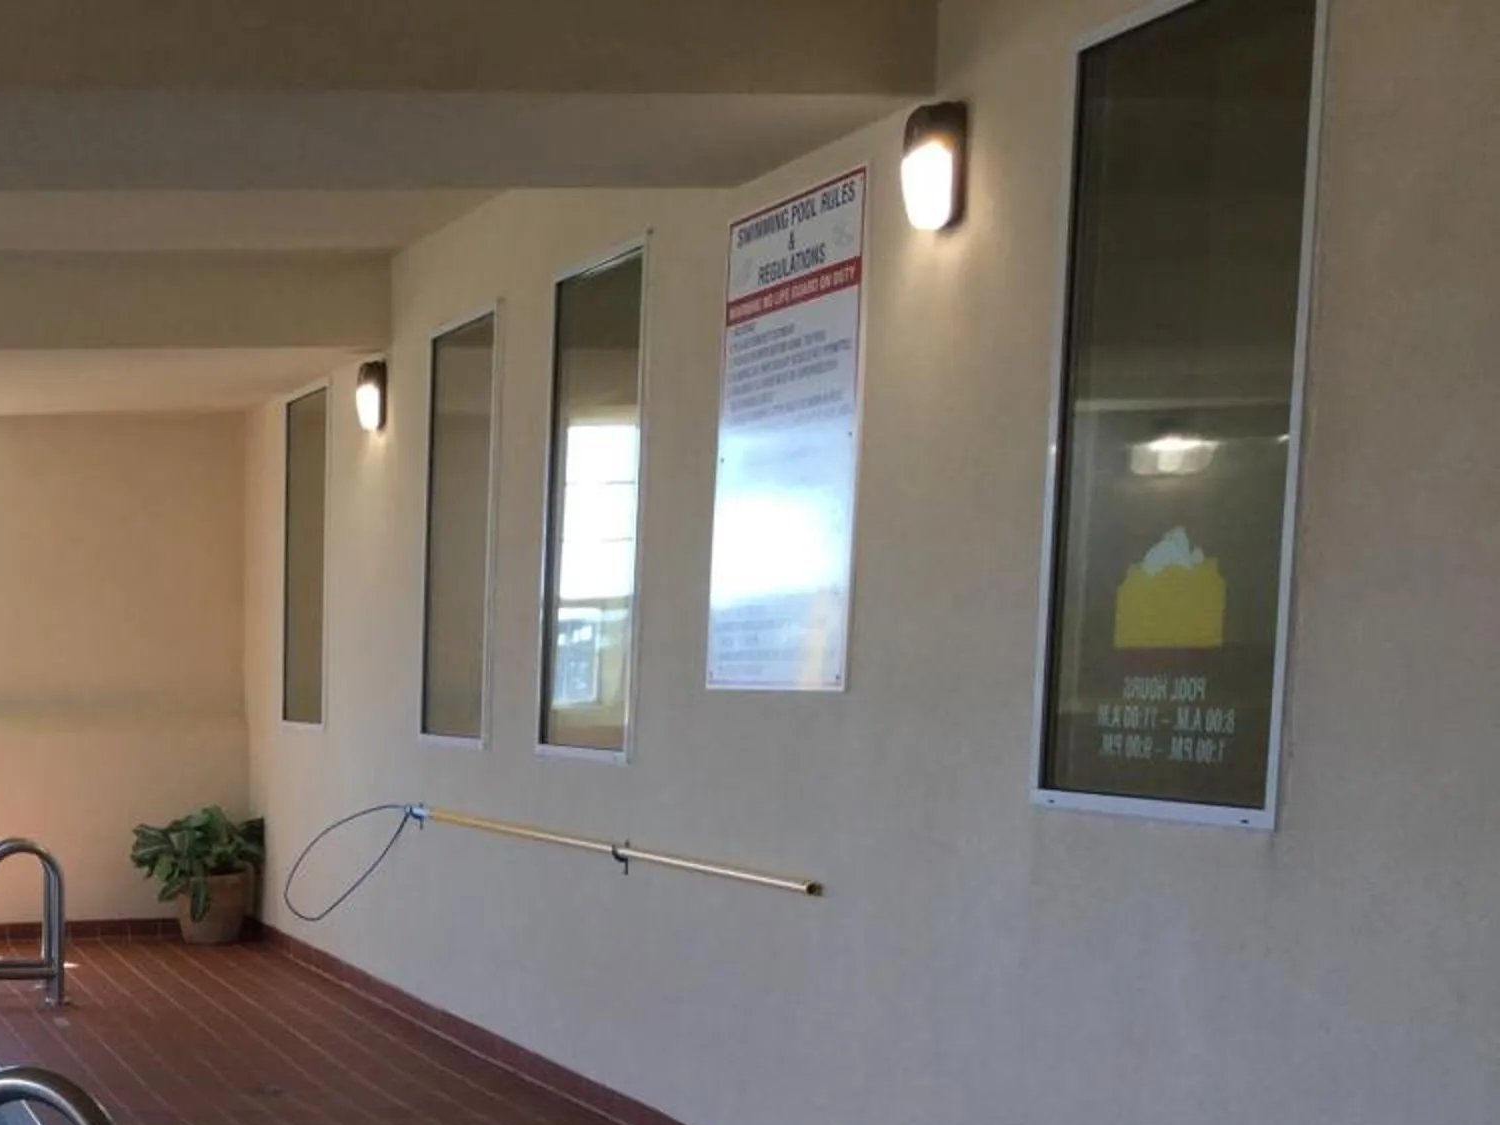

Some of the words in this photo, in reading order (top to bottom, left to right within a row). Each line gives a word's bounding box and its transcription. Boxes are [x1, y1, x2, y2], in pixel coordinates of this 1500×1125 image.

[737, 207, 789, 249] SWIMMING
[791, 198, 817, 225] POOL
[820, 180, 856, 214] RULES
[787, 229, 796, 251] &
[757, 242, 826, 286] REGULATIONS
